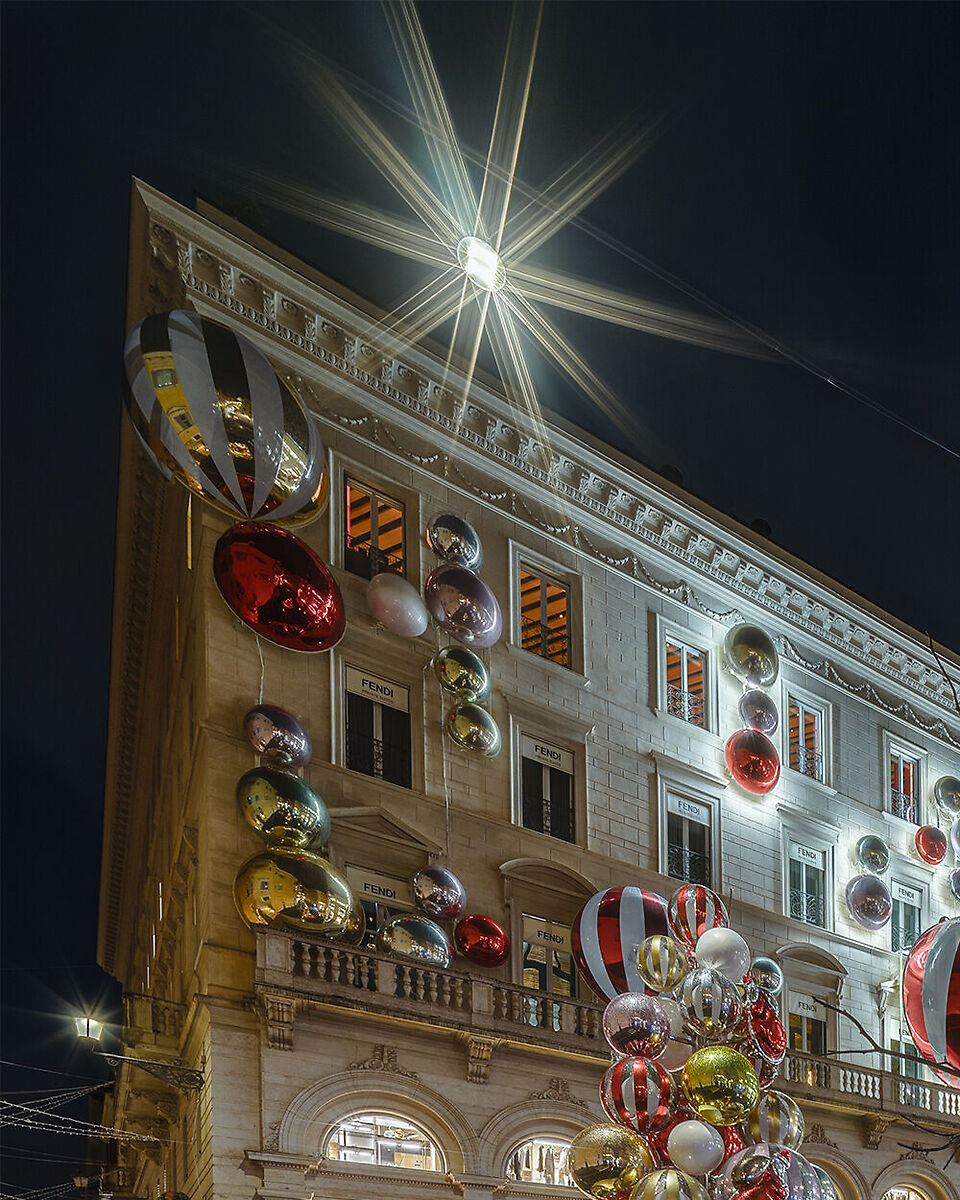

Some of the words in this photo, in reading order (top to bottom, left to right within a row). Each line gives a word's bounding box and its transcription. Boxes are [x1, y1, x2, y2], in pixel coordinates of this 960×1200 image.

[361, 678, 394, 698] FENDI
[535, 744, 562, 761] FENDI
[678, 800, 700, 815] FENDI
[363, 882, 396, 899] FENDI
[537, 930, 564, 944] FENDI
